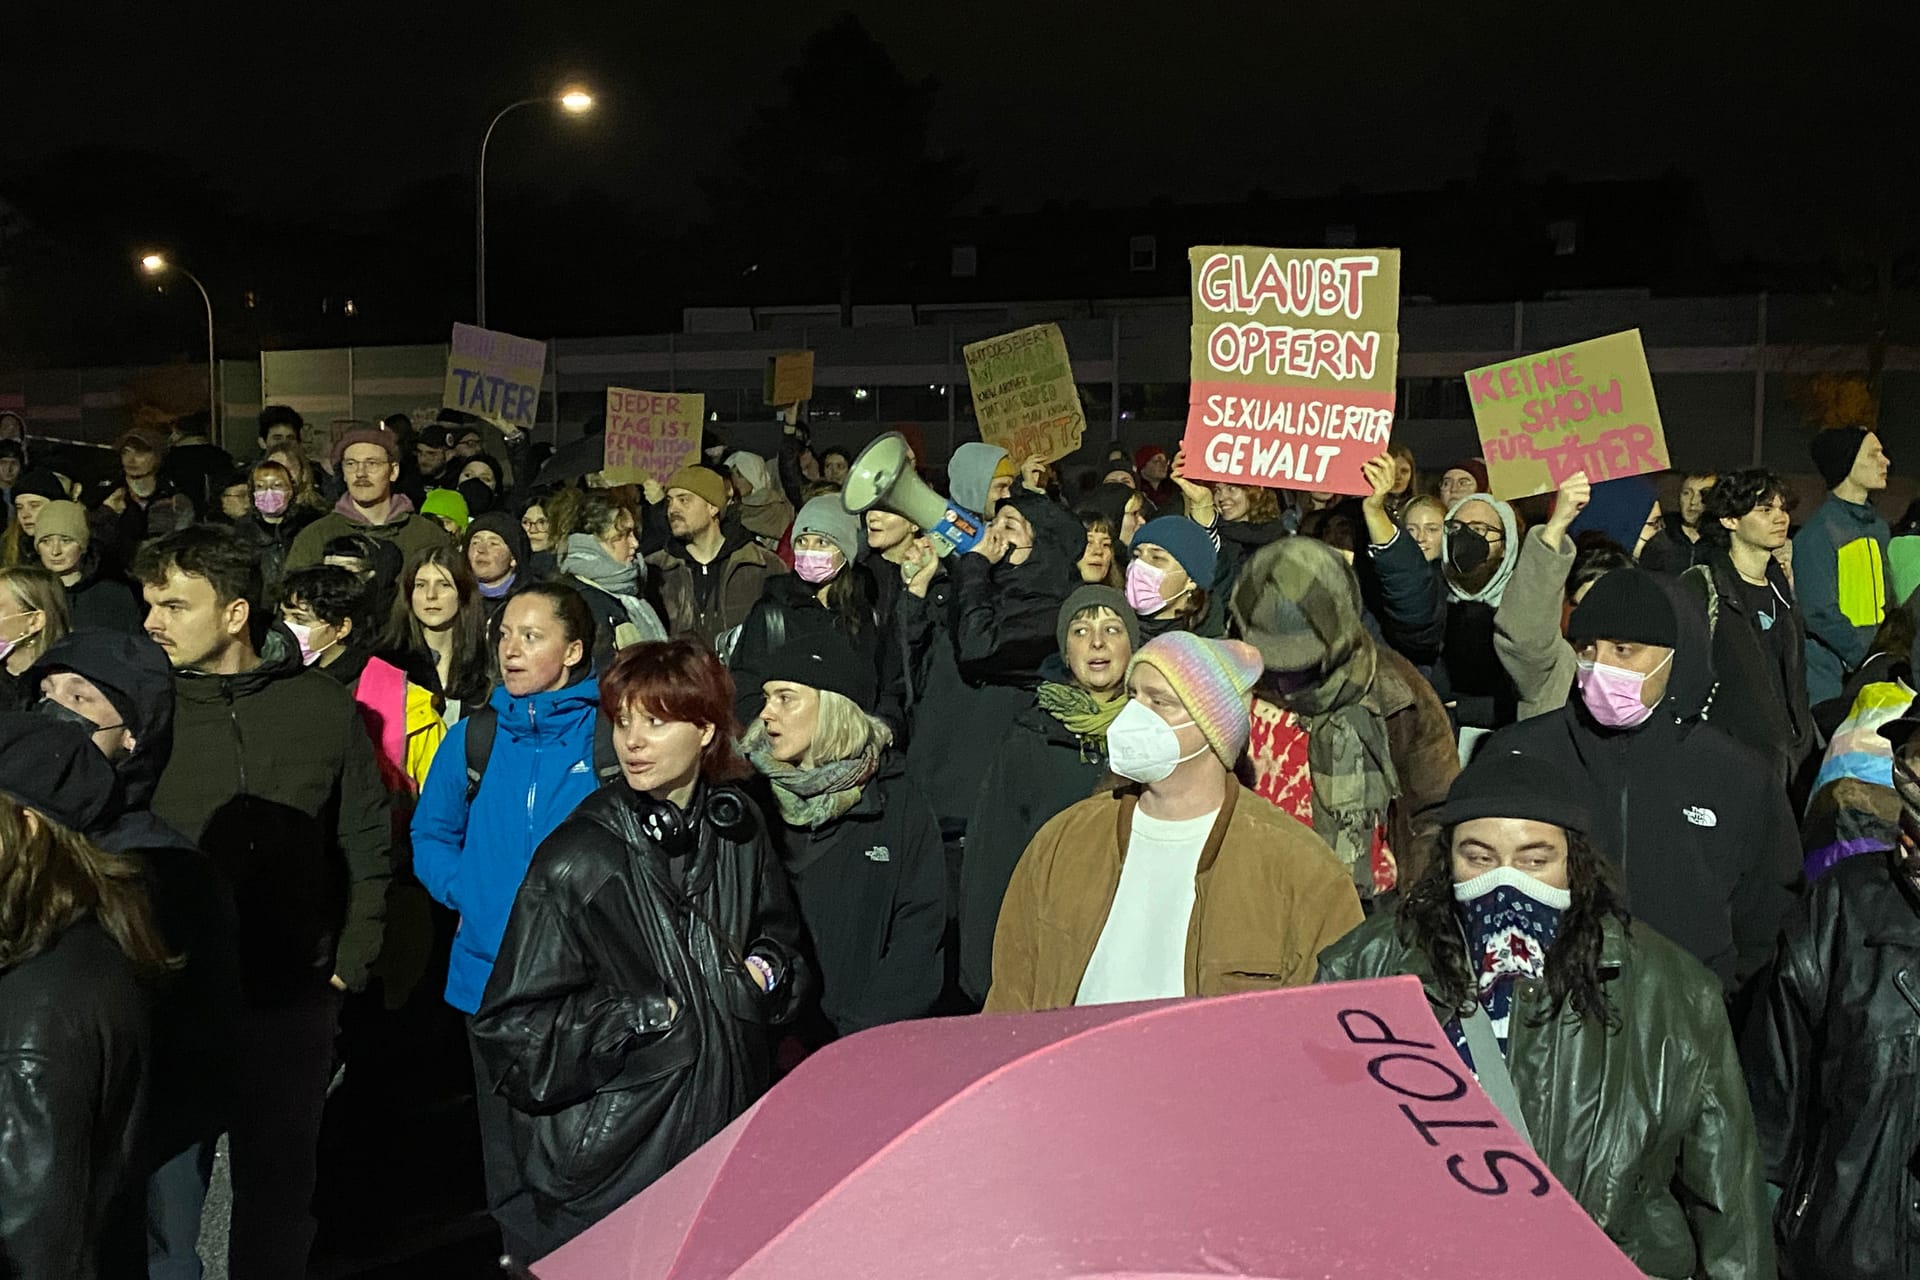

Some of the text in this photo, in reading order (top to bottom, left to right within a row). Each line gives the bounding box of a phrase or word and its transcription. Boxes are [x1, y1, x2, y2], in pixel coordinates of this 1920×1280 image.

[1199, 253, 1378, 319] GLAUBT
[1208, 322, 1380, 381] OPFERN
[609, 391, 682, 415] JEDER
[1469, 352, 1584, 404] KEINE
[611, 416, 691, 438] TAG IST
[1203, 395, 1392, 444] SEXUALISIERTER
[1521, 379, 1623, 432] SHOW
[1205, 433, 1341, 483] GEWALT
[1483, 424, 1666, 489] FÜR TÄTER
[1337, 1009, 1550, 1197] STOP
